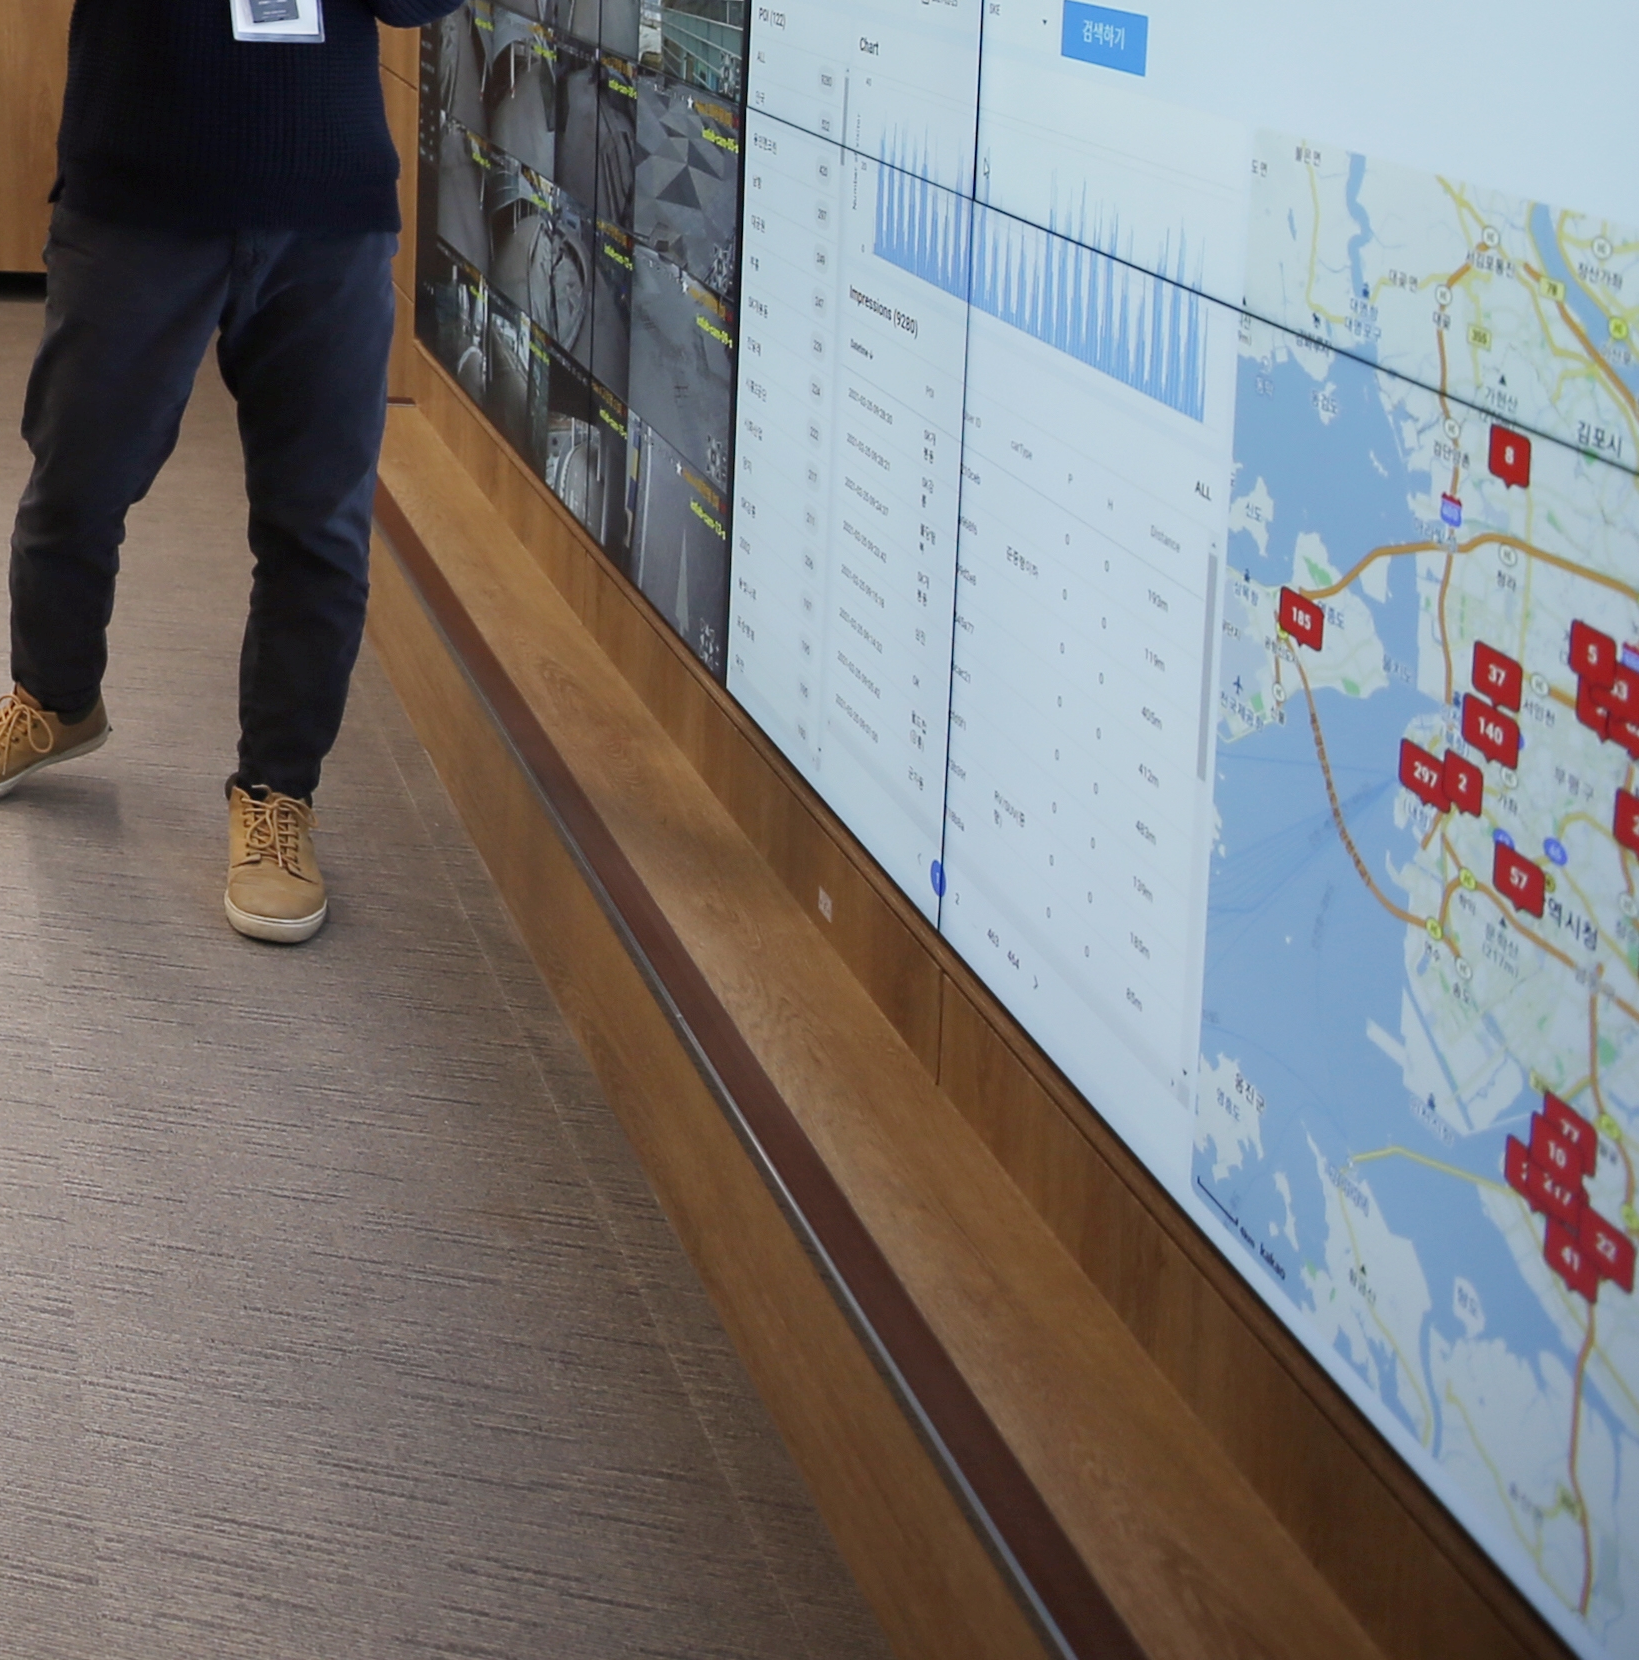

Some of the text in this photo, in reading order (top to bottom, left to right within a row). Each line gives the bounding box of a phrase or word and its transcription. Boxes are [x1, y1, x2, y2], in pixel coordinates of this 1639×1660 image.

[758, 7, 786, 30] POI (122)
[859, 37, 879, 56] Chart
[1081, 18, 1126, 51] 검색하기
[1389, 270, 1418, 292] 대곶면
[849, 285, 918, 339] Impressions (9280)
[1010, 440, 1033, 461] carType
[1578, 421, 1622, 458] 김포시
[1504, 442, 1514, 467] 8
[1194, 480, 1212, 501] ALL
[1245, 502, 1262, 523] 신도
[1150, 524, 1181, 553] Distance
[1147, 589, 1168, 612] 193m
[1290, 601, 1312, 634] 185
[1145, 647, 1165, 672] 119m
[1588, 644, 1598, 664] 5
[1488, 664, 1506, 686] 37
[1141, 706, 1161, 725] 405m
[1479, 717, 1503, 745] 140
[1138, 763, 1159, 788] 412m
[1413, 761, 1438, 787] 297
[1458, 773, 1467, 792] 2
[1135, 820, 1155, 840] 483m
[1133, 875, 1153, 901] 139m
[1510, 866, 1528, 889] 57
[987, 928, 999, 948] 463
[1130, 932, 1150, 957] 185m
[1007, 950, 1020, 970] 464
[1126, 987, 1143, 1012] 85m
[1235, 1073, 1265, 1113] 옹진군
[1547, 1135, 1566, 1173] 10
[1561, 1246, 1579, 1271] 41
[1595, 1226, 1618, 1269] 22
[1259, 1243, 1286, 1281] kakao
